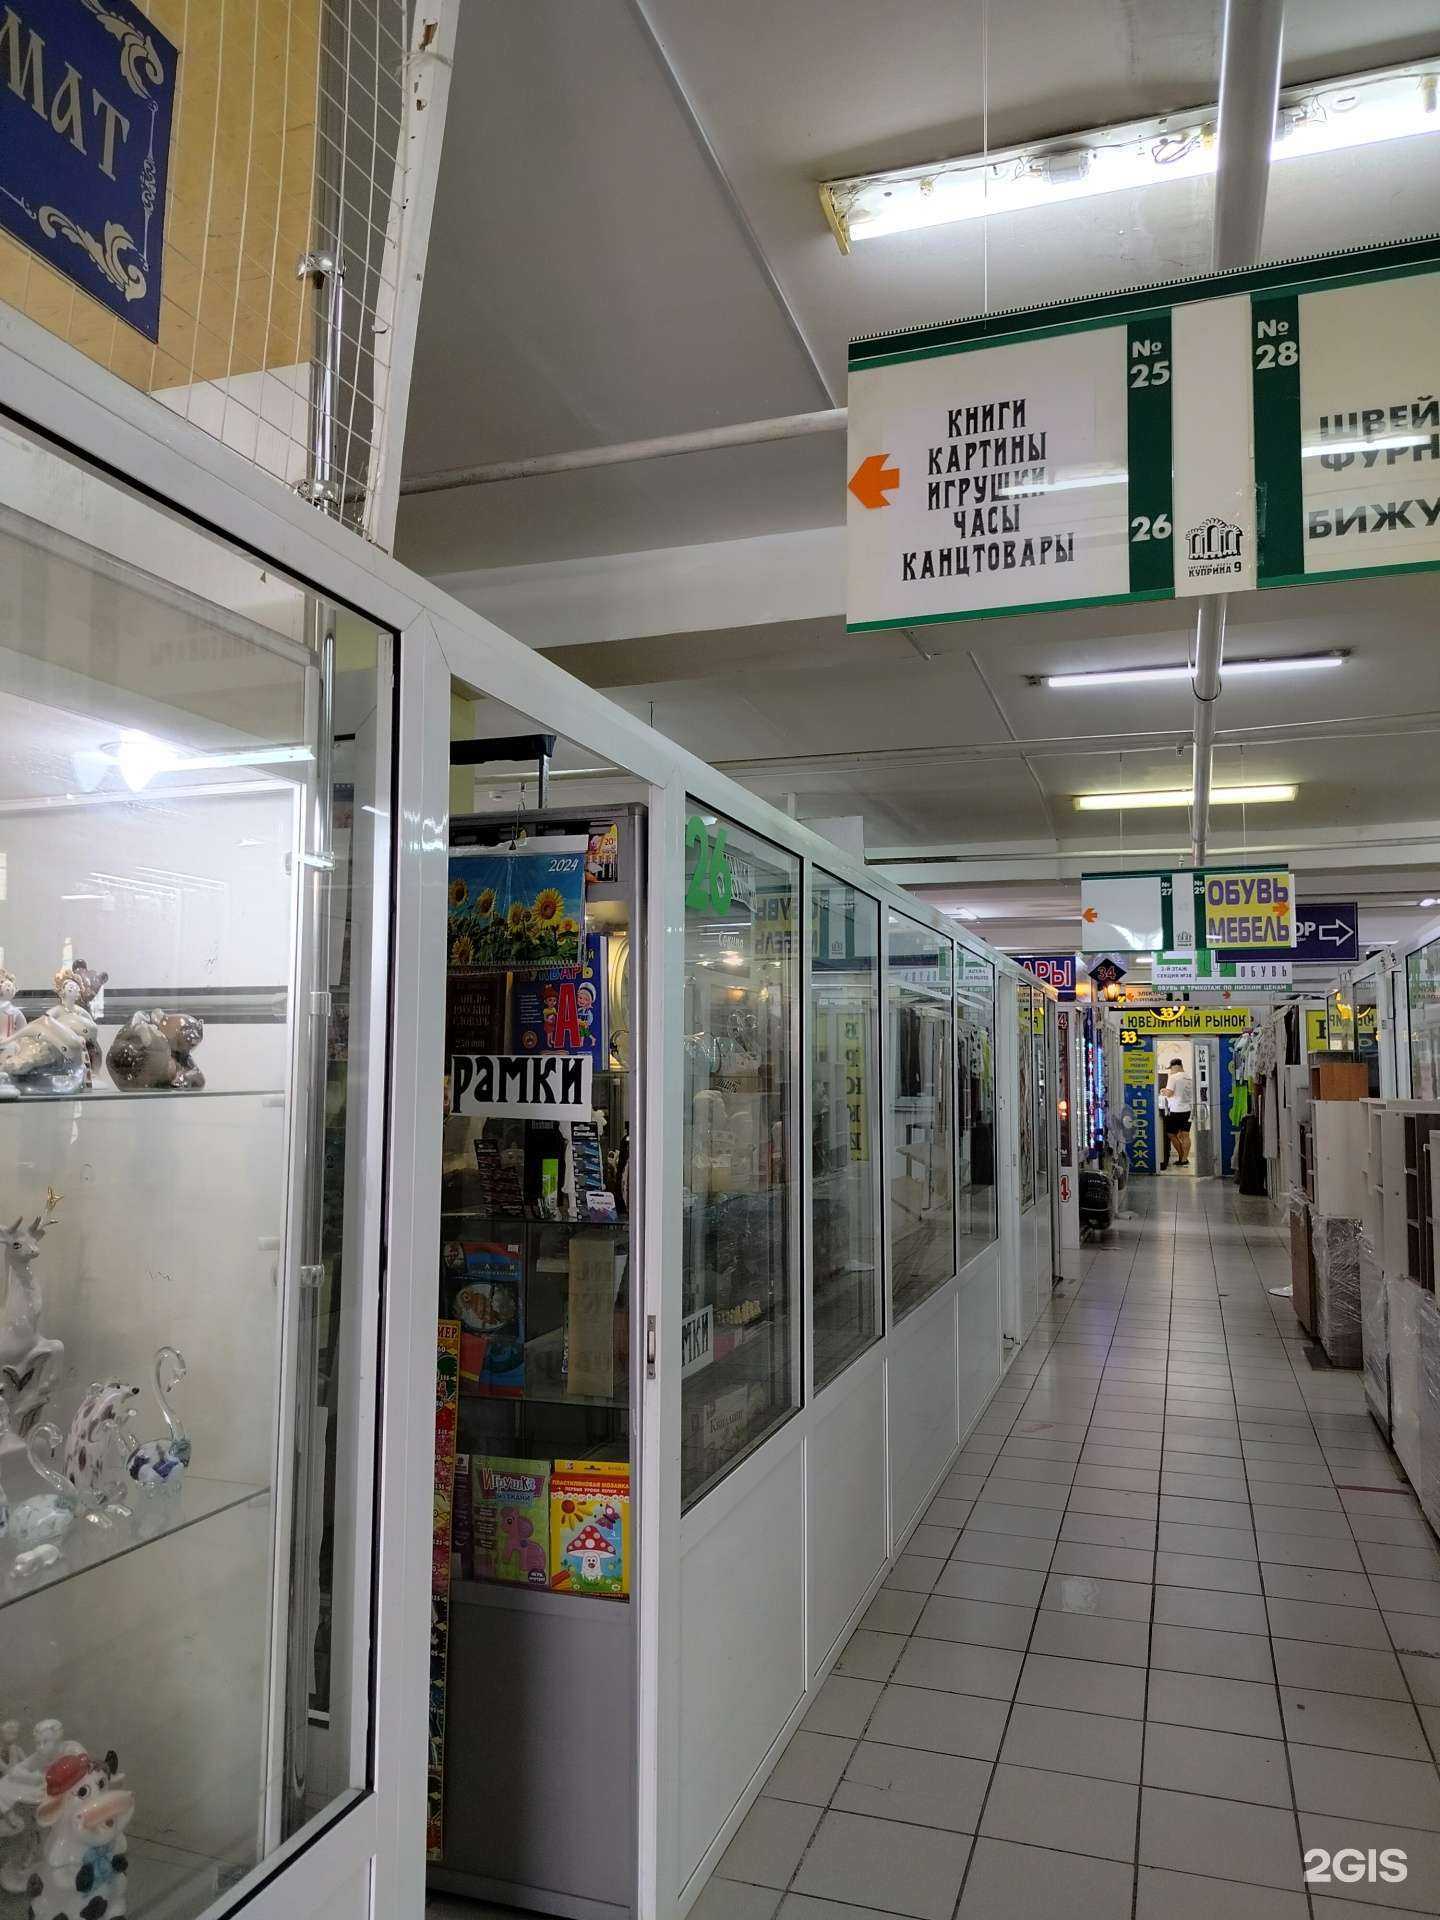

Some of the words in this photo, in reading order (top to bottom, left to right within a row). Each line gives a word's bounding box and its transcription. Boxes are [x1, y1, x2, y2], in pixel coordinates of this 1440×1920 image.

[1255, 341, 1299, 370] 28
[1130, 361, 1170, 389] 25
[948, 399, 1026, 438] КНИГИ
[928, 432, 1047, 476] КАРТИНЫ
[928, 467, 1046, 511] ИГРУШКИ
[953, 504, 1020, 539] ЧАСЫ
[1130, 513, 1173, 543] 26
[1309, 497, 1440, 539] БИЖУ
[902, 532, 1075, 581] КАНЦТОВАРЫ
[1188, 566, 1231, 578] КУПРИНА
[1233, 561, 1242, 573] 9
[548, 857, 580, 872] 2024
[684, 815, 732, 916] 26
[1160, 888, 1172, 896] 27
[1193, 886, 1205, 895] 29
[1207, 877, 1289, 906] ОБУВЬ
[1208, 915, 1290, 944] МЕБЕЛЬ
[1097, 966, 1116, 980] 34
[1240, 966, 1287, 978] ОБУВЬ
[554, 982, 582, 1048] А
[1127, 1014, 1201, 1028] ЮВЕЛИРНЫЙ
[1205, 1014, 1246, 1028] РЫНОК
[1121, 1031, 1138, 1044] 33
[1132, 1098, 1149, 1168] ПРОДАЖА
